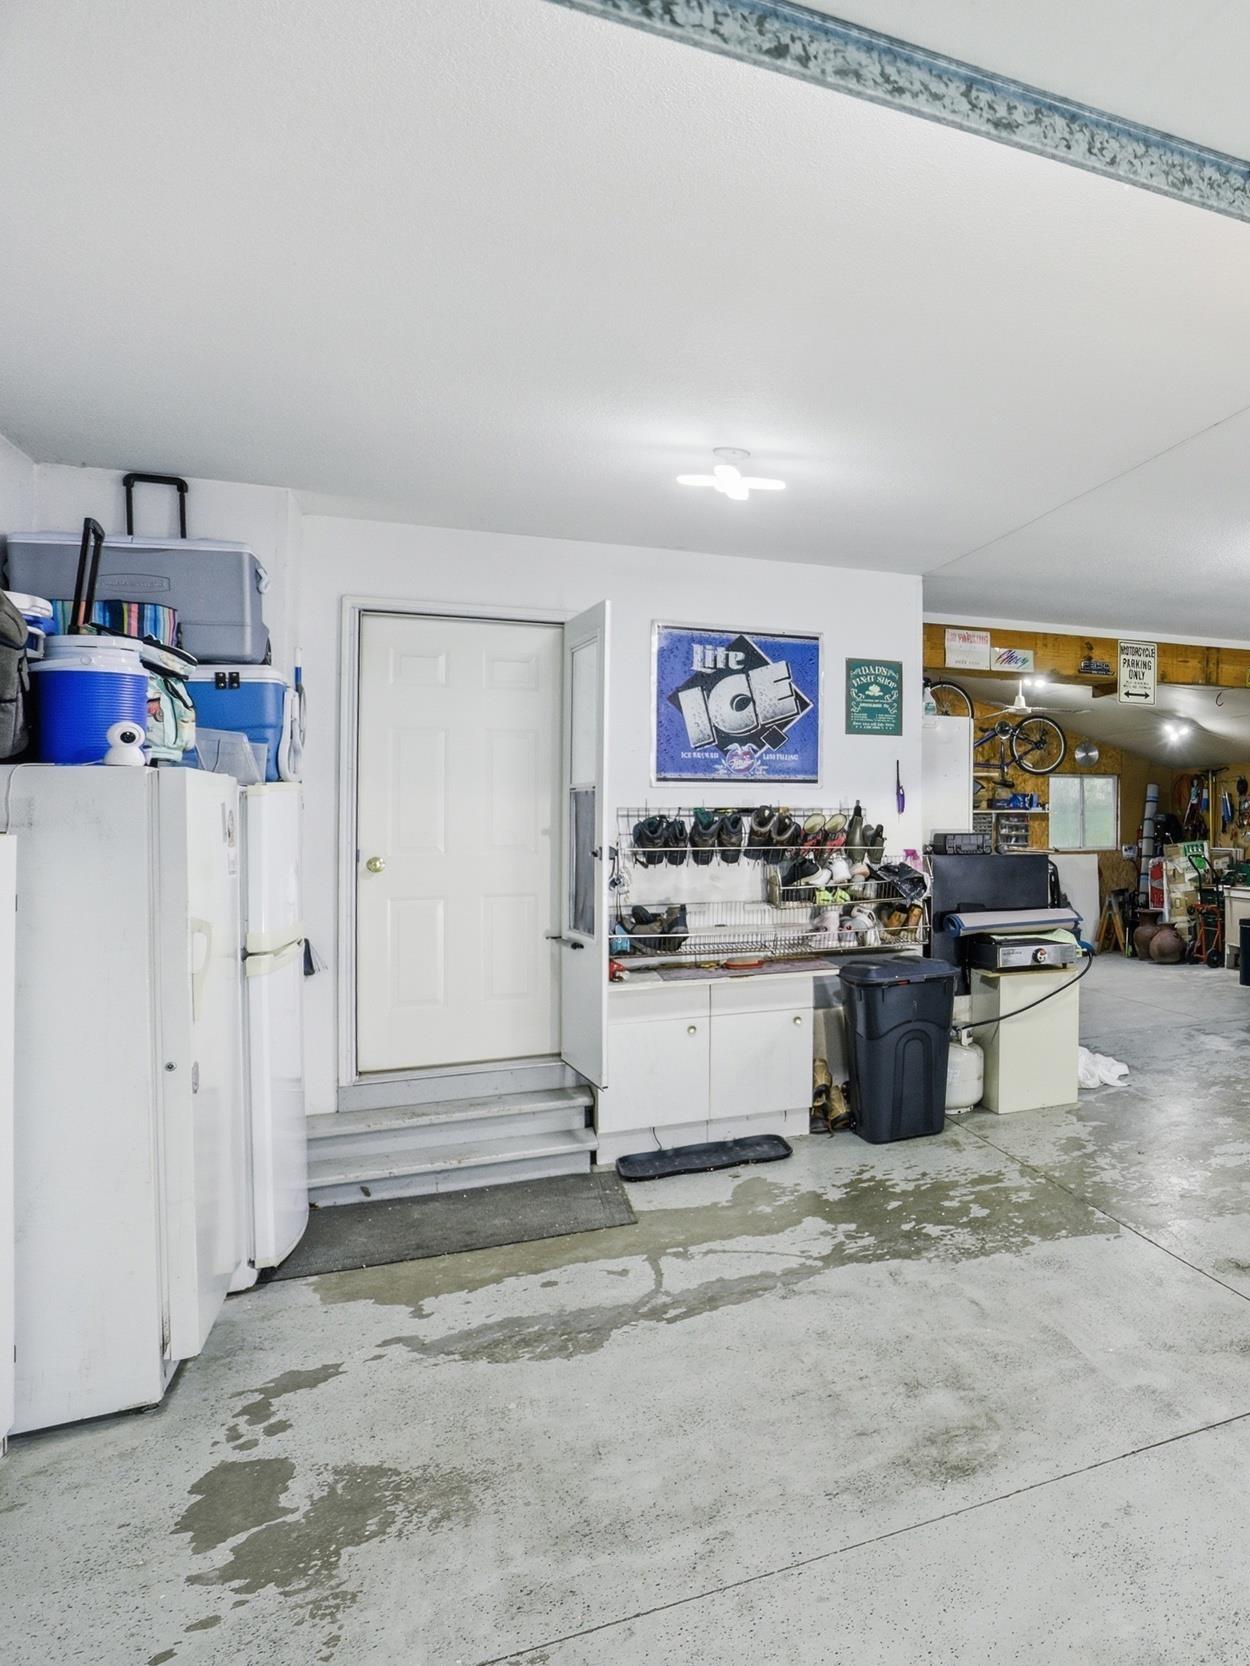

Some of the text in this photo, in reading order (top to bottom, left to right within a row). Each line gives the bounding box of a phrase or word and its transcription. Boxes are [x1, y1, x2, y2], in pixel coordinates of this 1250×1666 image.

[691, 643, 746, 674] Lite
[994, 649, 1030, 669] Chevy
[1120, 645, 1156, 659] MOTORCYCLE
[1122, 658, 1152, 671] PARKING
[1128, 669, 1146, 681] ONLY
[678, 660, 801, 751] ICE
